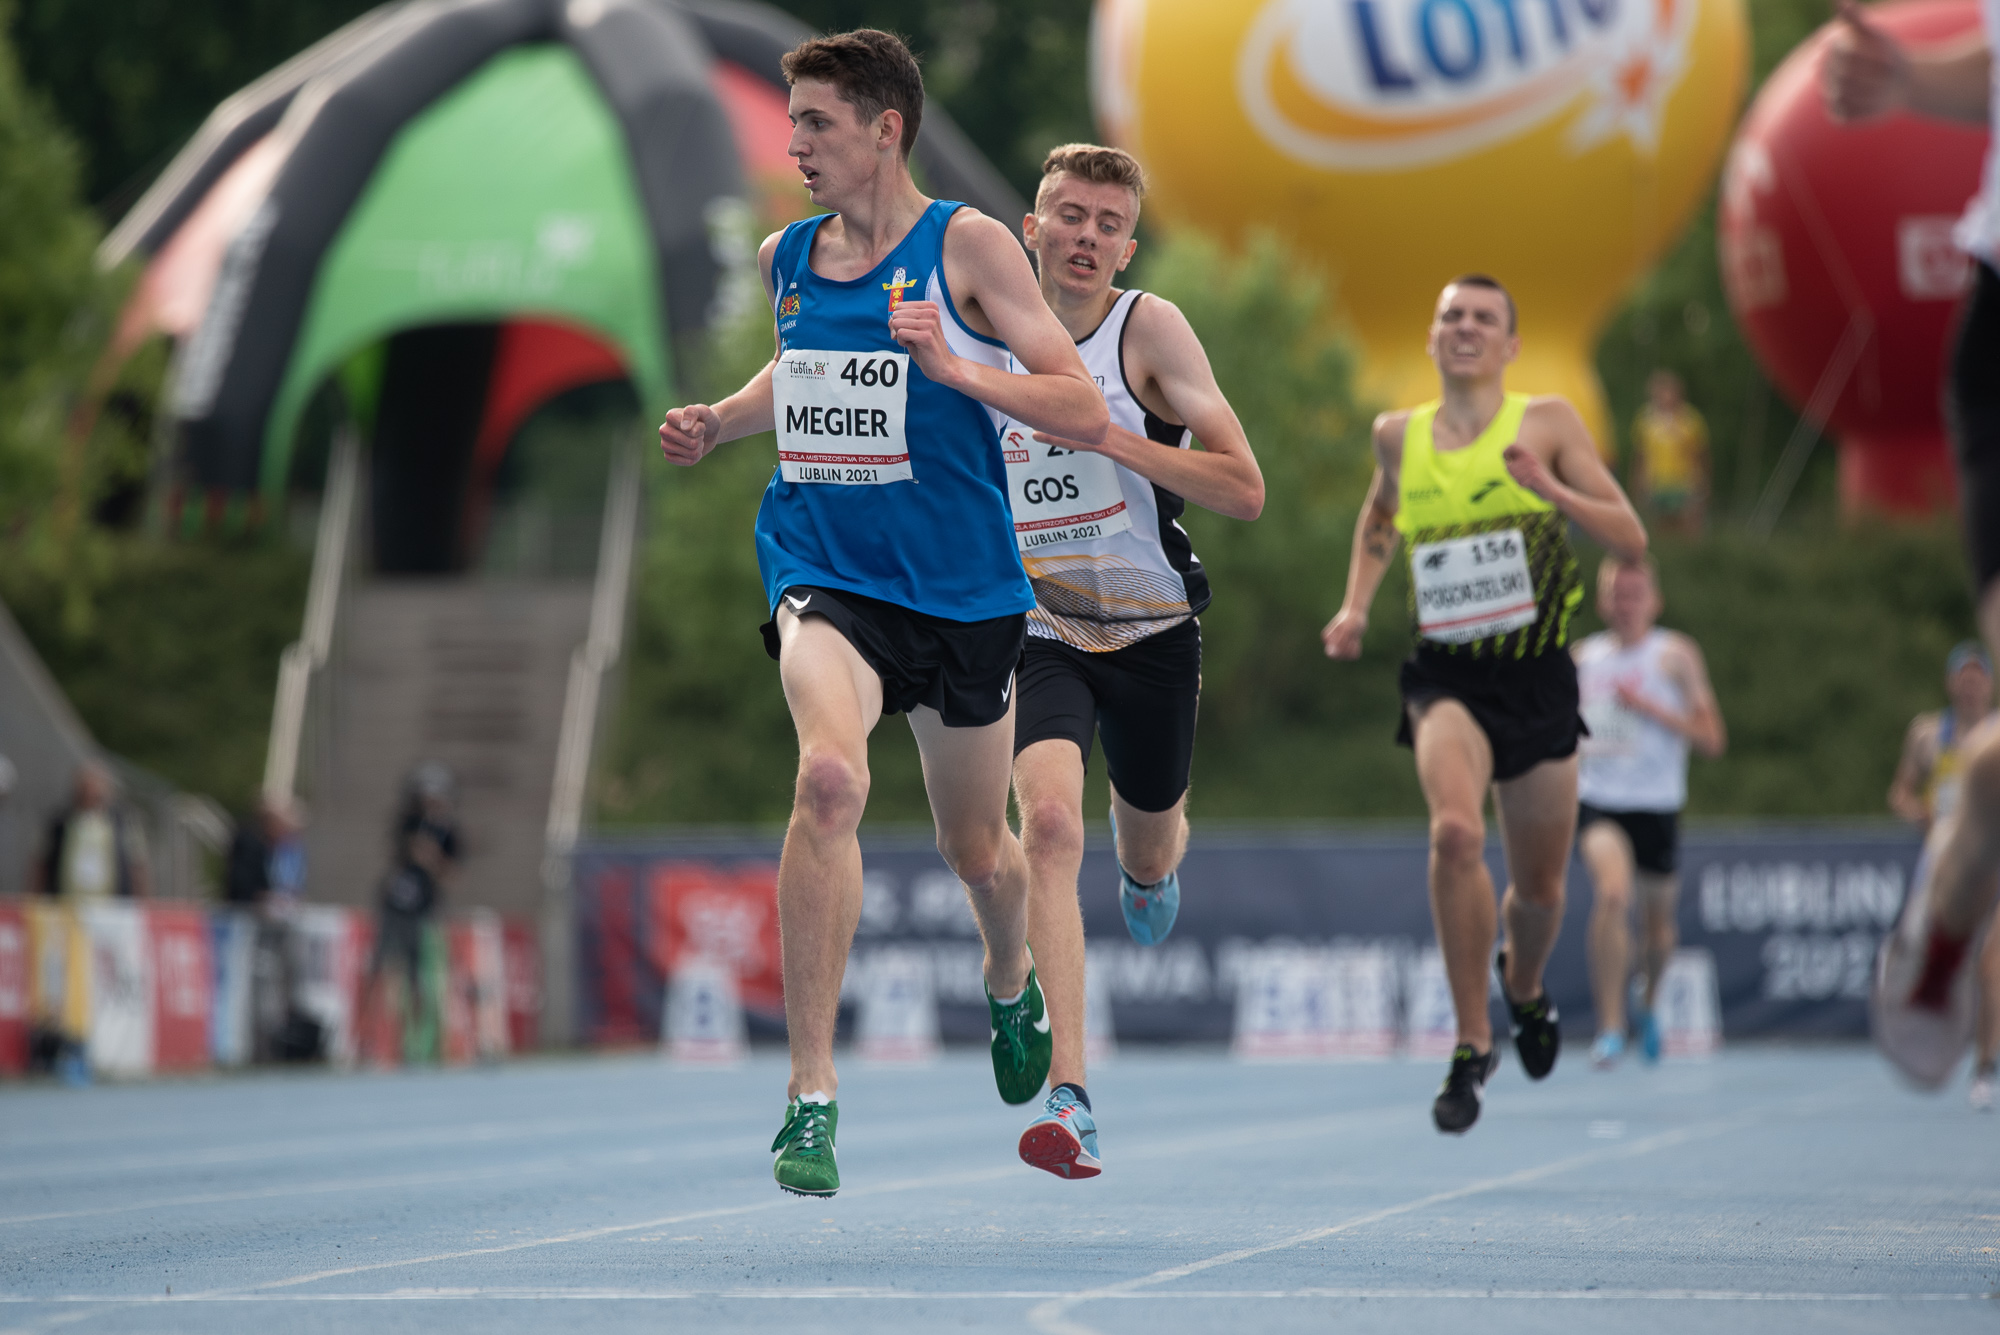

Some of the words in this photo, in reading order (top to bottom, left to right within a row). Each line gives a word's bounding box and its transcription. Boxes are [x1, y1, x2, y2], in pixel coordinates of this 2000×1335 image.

[840, 358, 900, 388] 460
[786, 405, 890, 438] MEGIER
[805, 455, 857, 463] MISTRZOSTWA
[1003, 451, 1027, 462] RLEN
[799, 467, 842, 481] LUBLIN
[845, 468, 878, 482] 2021
[1023, 474, 1080, 505] GOS
[1028, 517, 1079, 530] MISTRZOSTWA
[1080, 511, 1106, 521] POLSKI
[1024, 530, 1068, 548] LUBLIN
[1070, 524, 1102, 540] 2021
[1471, 537, 1518, 566] 156
[1701, 864, 1906, 932] LUBLIN
[1762, 933, 1876, 999] 202
